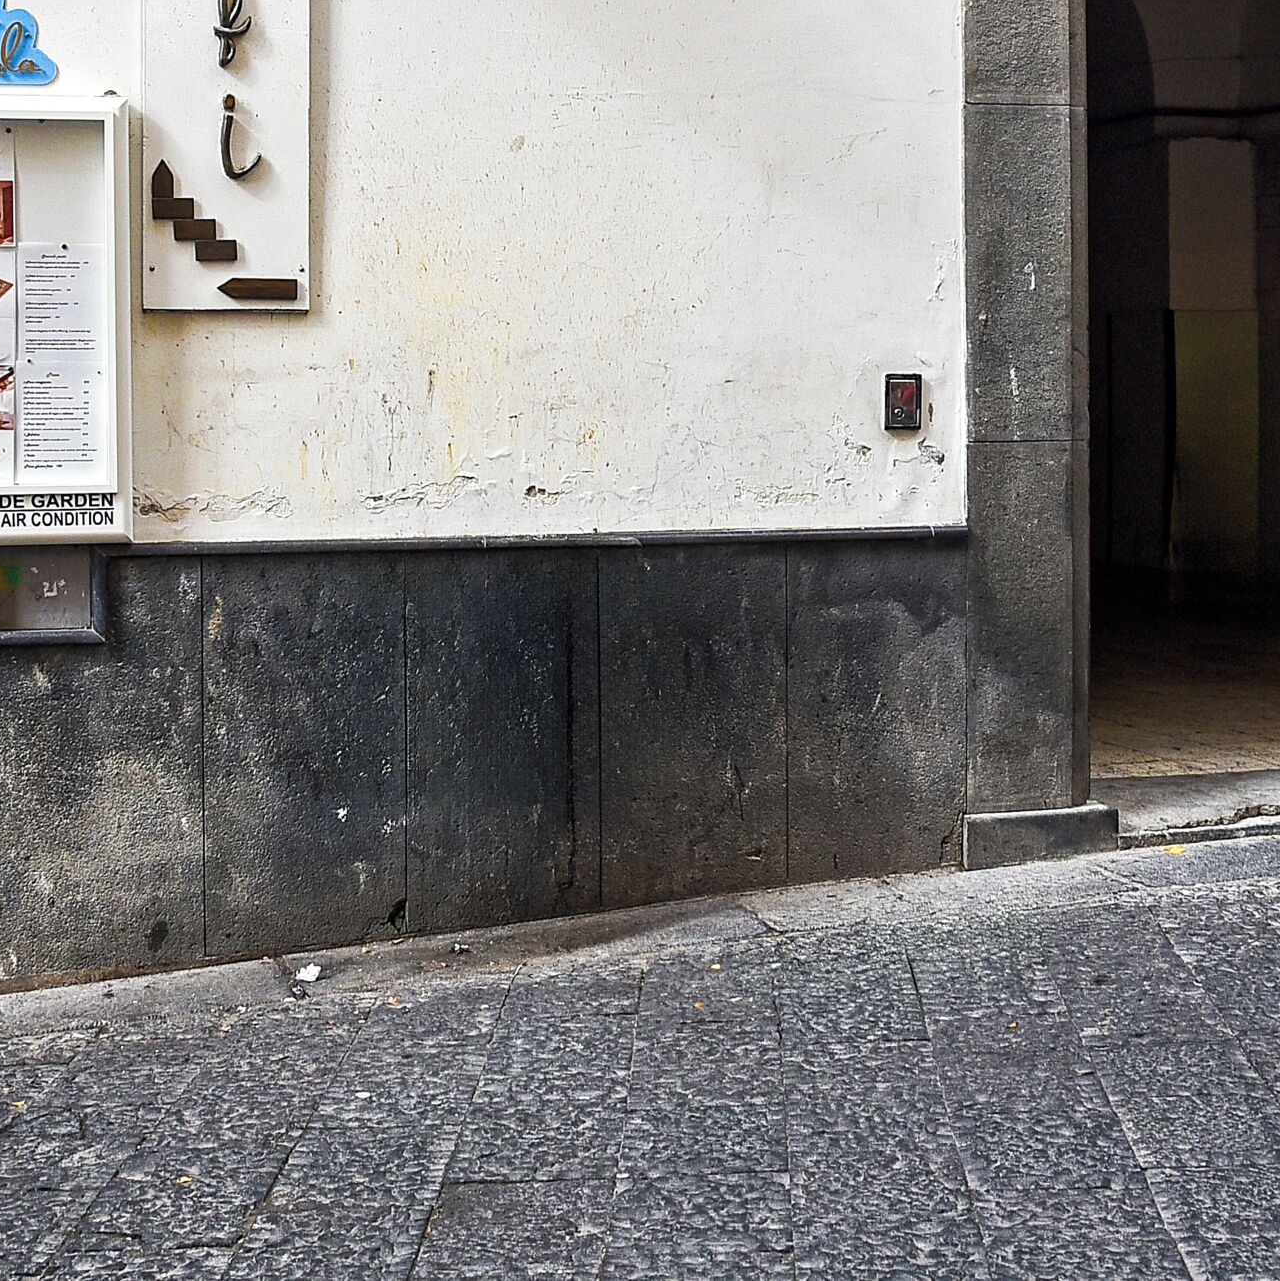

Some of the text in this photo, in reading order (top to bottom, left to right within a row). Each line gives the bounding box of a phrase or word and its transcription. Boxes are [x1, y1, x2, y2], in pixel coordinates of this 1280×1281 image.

[31, 493, 114, 508] GARDEN
[0, 512, 26, 528] AIR
[30, 511, 114, 527] CONDITION
